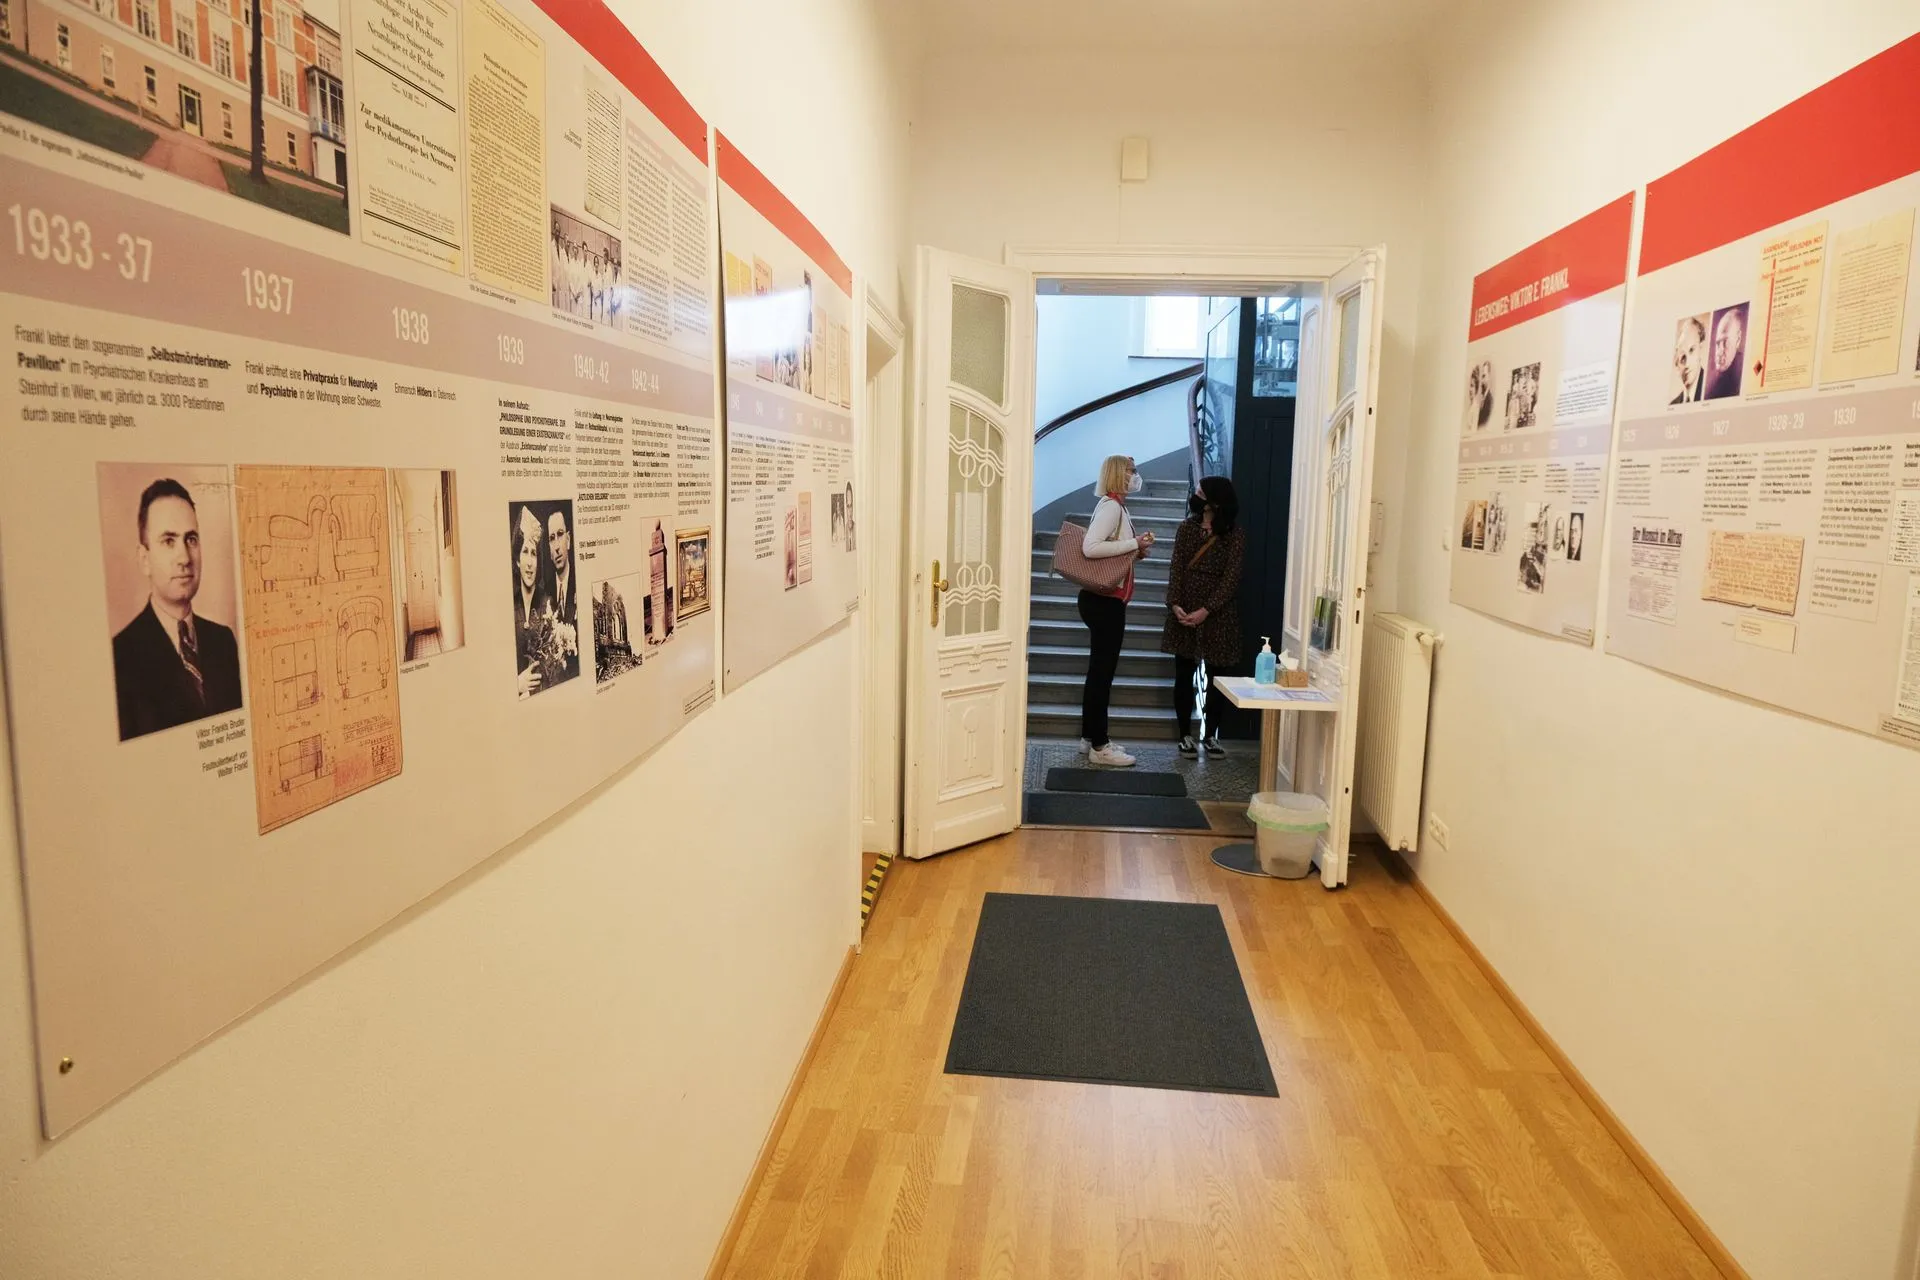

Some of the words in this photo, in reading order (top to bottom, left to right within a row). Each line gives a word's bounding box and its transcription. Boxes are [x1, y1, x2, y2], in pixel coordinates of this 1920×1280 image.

[8, 202, 95, 271] 1933
[101, 250, 111, 262] -
[116, 231, 153, 284] 37
[241, 265, 294, 316] 1937
[1510, 284, 1533, 311] VIKTOR
[1540, 267, 1569, 299] FRANKL
[15, 324, 45, 342] Frankl
[46, 329, 70, 345] leitet
[72, 333, 90, 348] den
[92, 338, 145, 357] sogenannten
[391, 305, 430, 346] 1938
[497, 333, 525, 366] 1939
[68, 360, 81, 374] im
[83, 360, 146, 382] Psychiatrischen
[148, 368, 196, 388] Krankenhaus
[198, 376, 209, 389] am
[245, 360, 264, 376] Frankl
[265, 363, 288, 379] eröffnet
[289, 368, 302, 380] eine
[303, 369, 339, 386] Privatpraxis
[339, 373, 348, 387] für
[348, 376, 378, 391] Neurologie
[19, 378, 58, 397] Steinhof
[61, 382, 70, 397] in
[71, 384, 98, 402] Wien,
[99, 390, 113, 401] wo
[114, 387, 145, 406] jährlich
[146, 394, 158, 406] ca.
[160, 392, 180, 408] 3000
[246, 383, 259, 395] und
[260, 383, 298, 400] Psychiatrie
[299, 389, 305, 400] in
[305, 390, 315, 401] der
[316, 390, 341, 405] Wohnung
[341, 394, 357, 406] seiner
[357, 394, 382, 408] Schwester.
[21, 404, 50, 422] durch
[51, 411, 76, 424] seine
[78, 410, 108, 426] Hände
[109, 413, 136, 429] gehen.
[1833, 406, 1857, 426] 1930
[196, 729, 210, 739] Viktor
[211, 723, 229, 735] Frankls
[229, 718, 246, 730] Bruder
